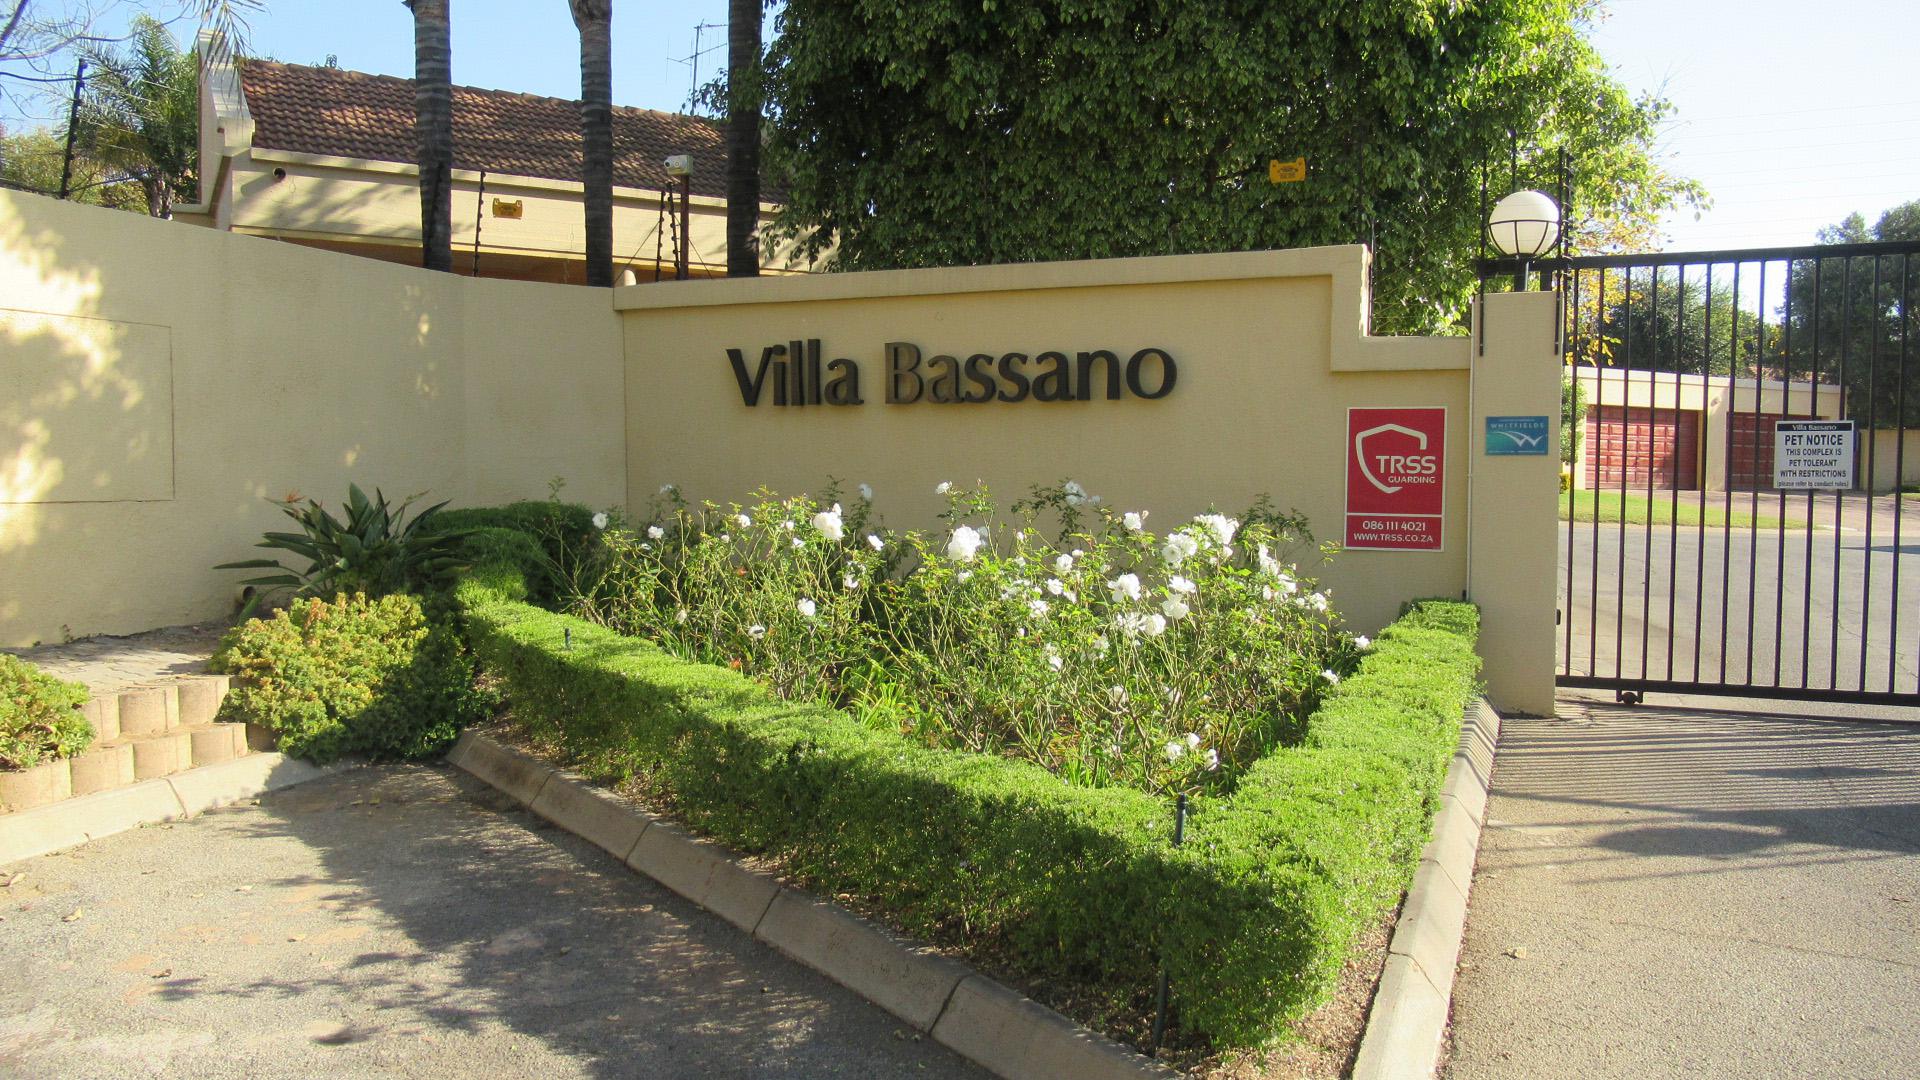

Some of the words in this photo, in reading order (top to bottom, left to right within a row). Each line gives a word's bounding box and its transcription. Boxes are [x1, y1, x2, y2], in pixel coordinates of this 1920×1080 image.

[726, 338, 865, 407] Villa
[884, 342, 1178, 405] Bassano
[1785, 434, 1803, 446] PET
[1806, 434, 1843, 446] NOTICE
[1786, 448, 1801, 456] THIS
[1802, 448, 1833, 456] COMPLEX
[1835, 448, 1842, 456] IS
[1375, 455, 1436, 475] TRSS
[1789, 459, 1802, 467] PET
[1803, 459, 1837, 467] TOLERANT
[1798, 470, 1847, 478] RESTRICTIONS
[1387, 476, 1436, 484] GUARDING
[1362, 520, 1384, 530] 086
[1386, 521, 1398, 531] 111
[1400, 521, 1426, 531] 4021
[1353, 532, 1434, 543] WWW.TRSS.CO.ZA
